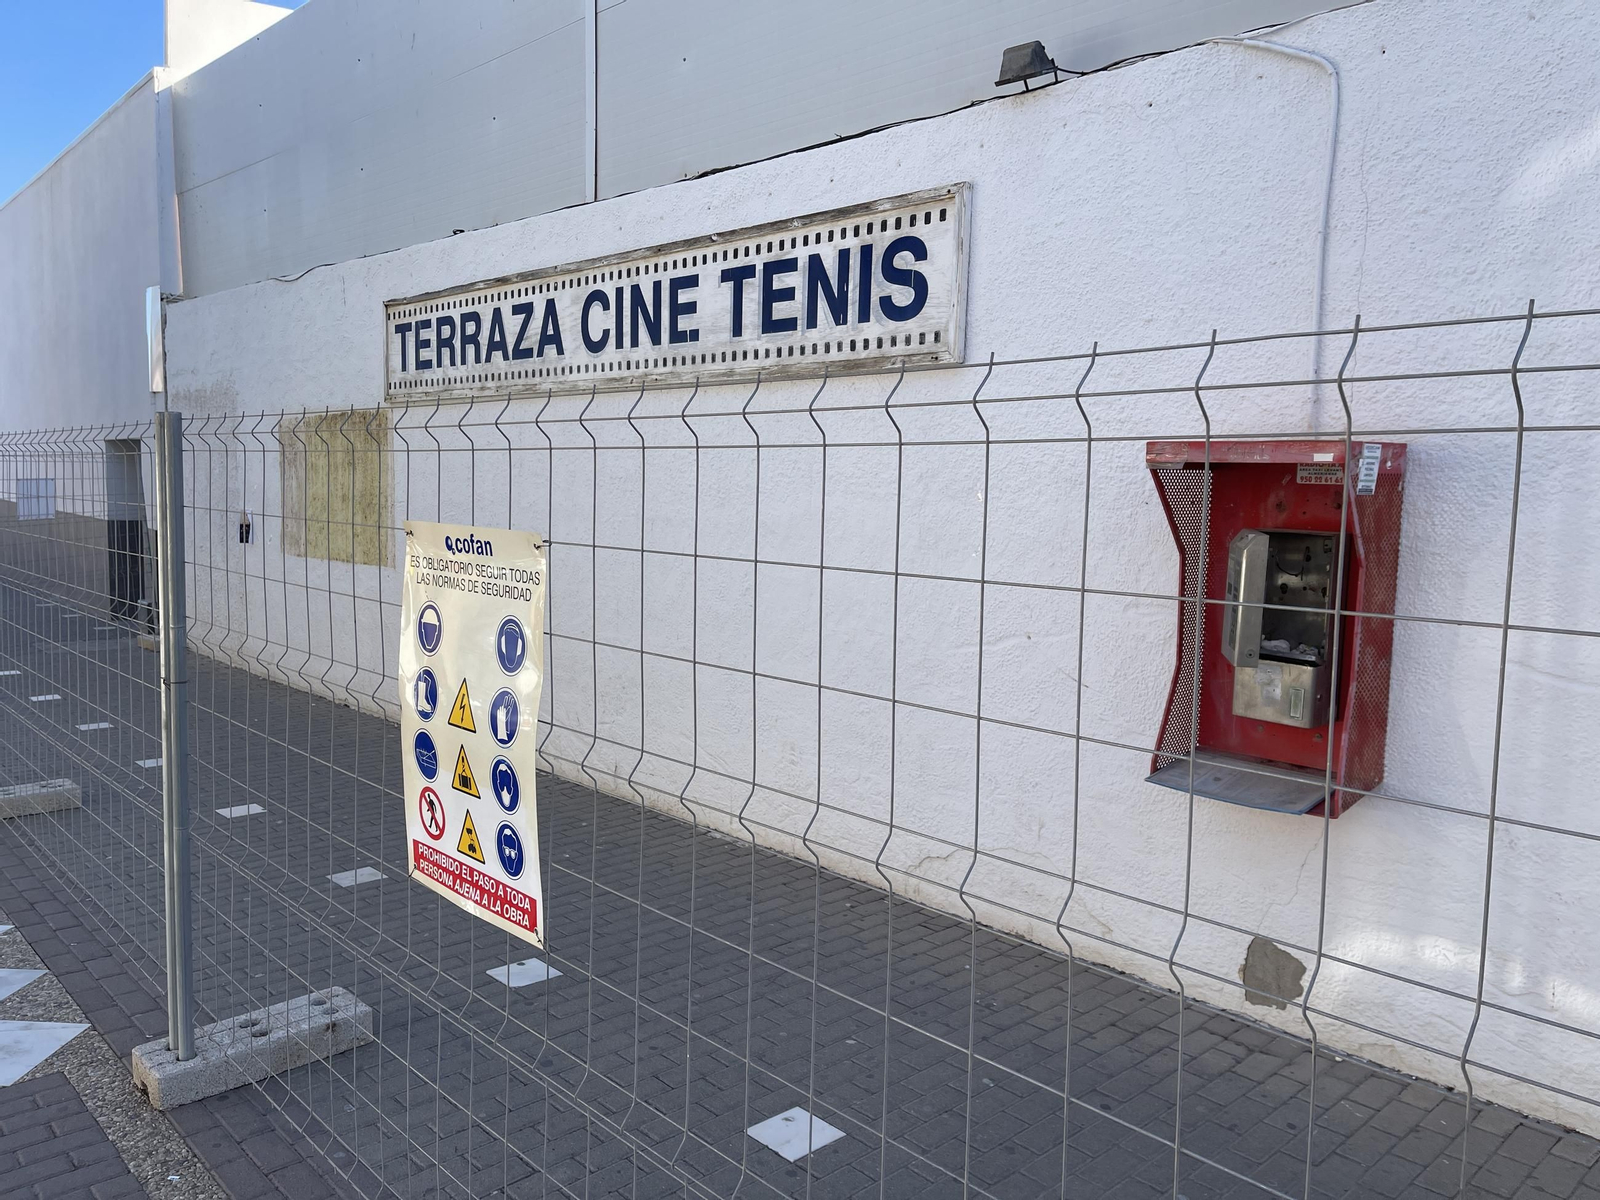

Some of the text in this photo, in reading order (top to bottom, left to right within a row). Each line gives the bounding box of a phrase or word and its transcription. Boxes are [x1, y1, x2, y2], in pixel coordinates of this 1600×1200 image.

[394, 235, 929, 373] TERRAZA CINE TENIS
[1299, 475, 1313, 483] 950
[455, 533, 493, 557] cofan
[410, 555, 541, 586] ES OBLIGATORIO SEGUIR TODAS
[416, 571, 532, 602] LAS NORMAS DE SEGURIDAD
[418, 843, 531, 912] PROHIBIDO EL PASO A TODA
[419, 859, 530, 928] PERSONA AJENA A LA OBRA
